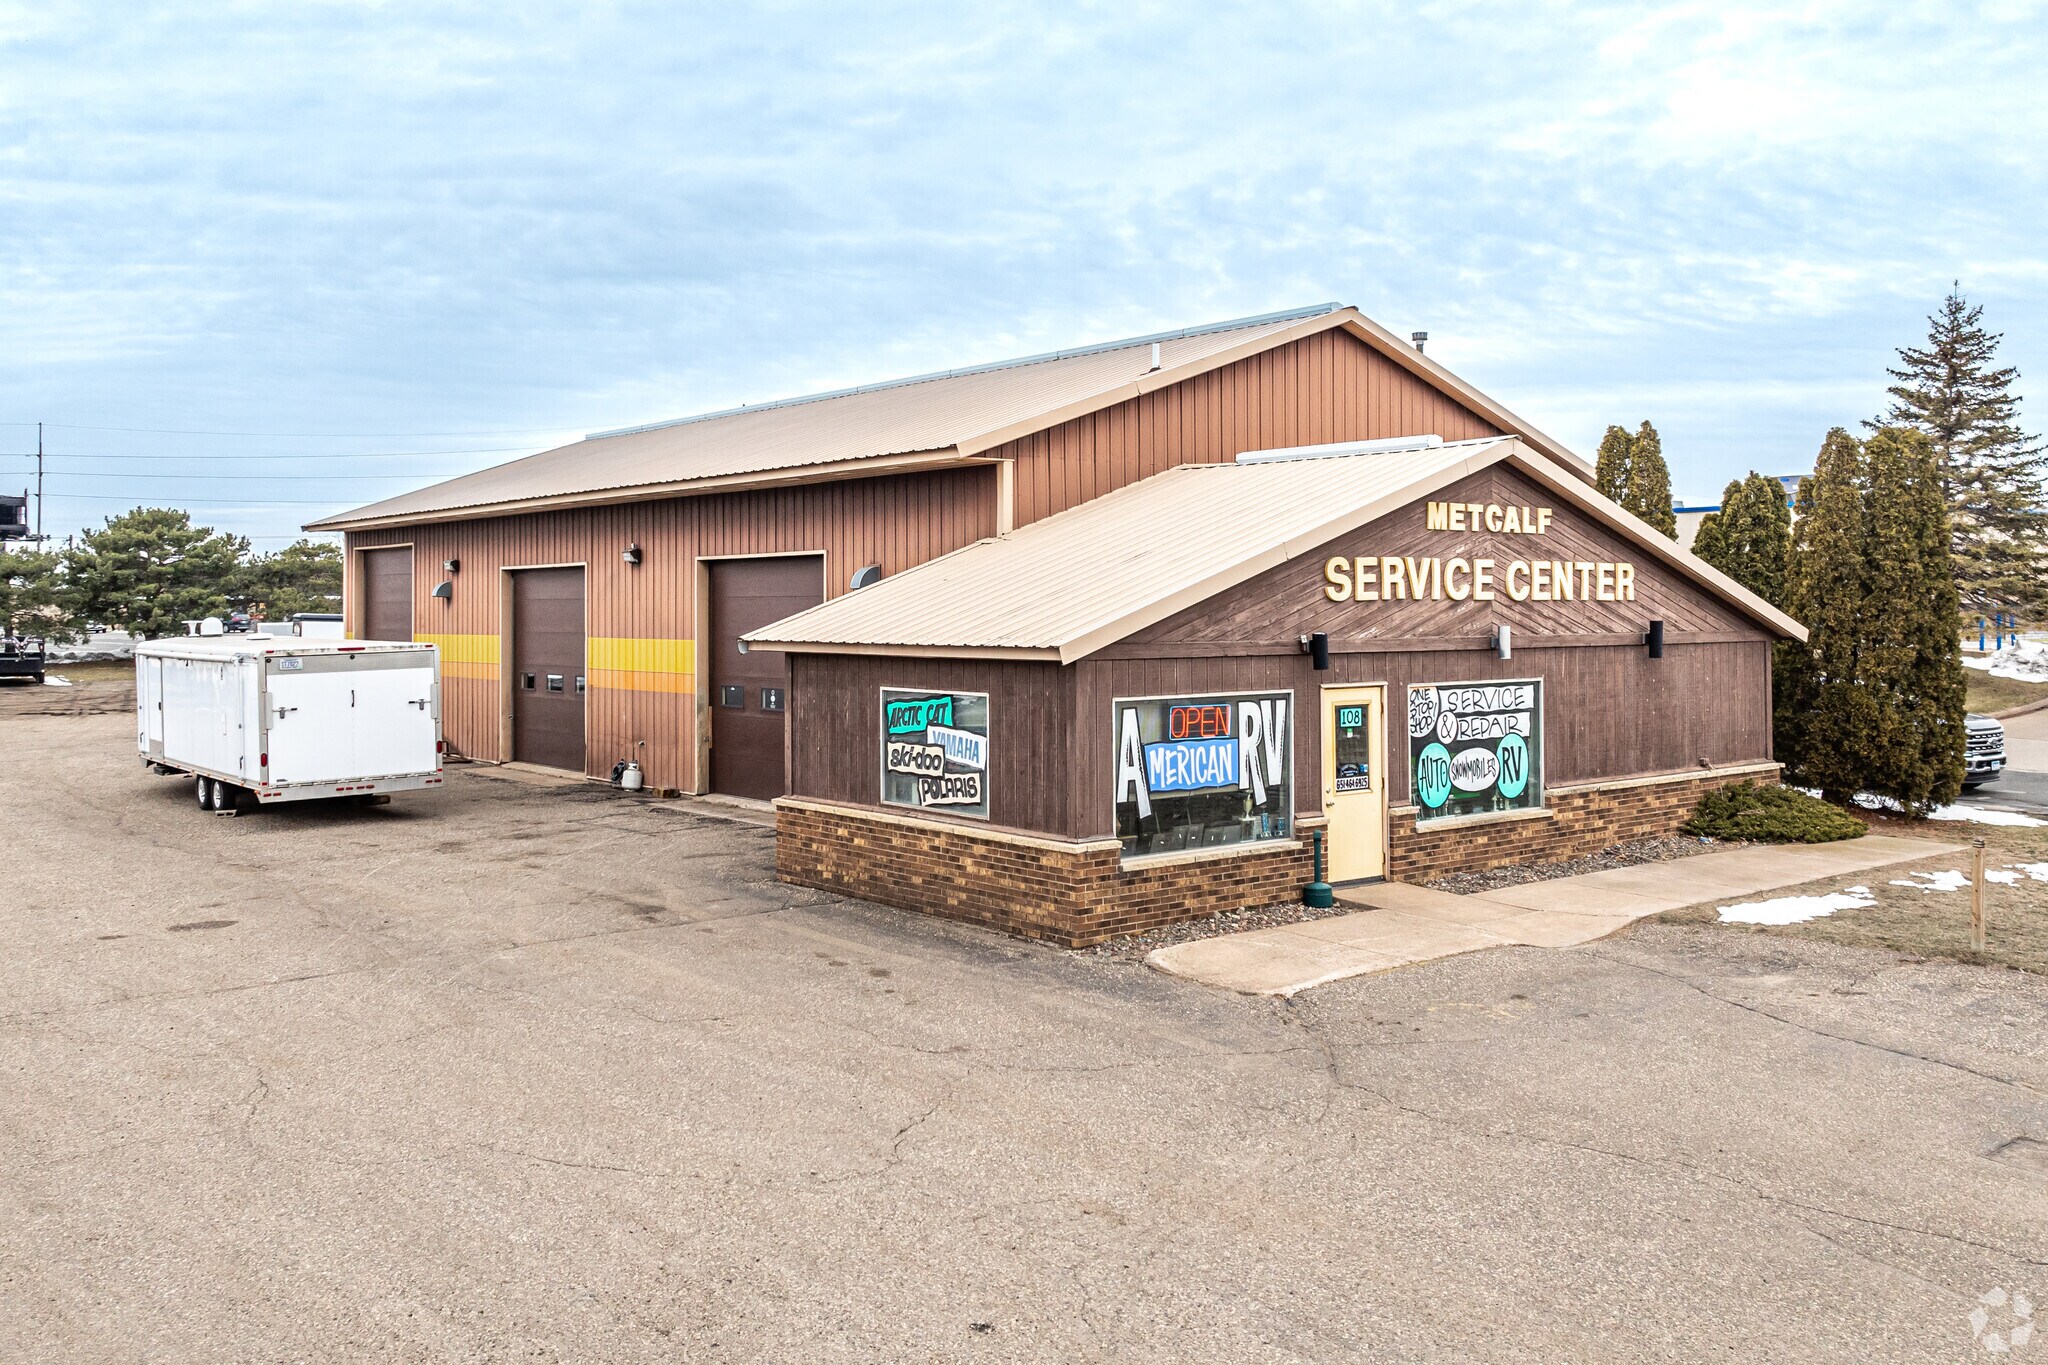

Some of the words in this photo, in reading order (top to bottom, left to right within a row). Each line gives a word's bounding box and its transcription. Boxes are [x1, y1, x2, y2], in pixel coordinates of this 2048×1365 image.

[1426, 501, 1552, 534] METCALF
[1324, 556, 1495, 602] SERVICE
[1505, 560, 1635, 602] CENTER
[1410, 688, 1430, 704] ONE
[1447, 687, 1524, 711] SERVICE
[890, 706, 922, 728] ARCTIC
[926, 702, 948, 727] CAT
[1171, 705, 1230, 738] OPEN
[1341, 710, 1360, 725] 108
[1441, 714, 1454, 739] &
[1459, 715, 1523, 738] REPAIR
[932, 730, 980, 764] YAMAHA
[1238, 699, 1287, 806] RV
[1420, 755, 1448, 800] AUTO
[1451, 756, 1497, 783] SNOWMOBILES
[1502, 745, 1522, 785] RV
[921, 776, 978, 803] POLARIS
